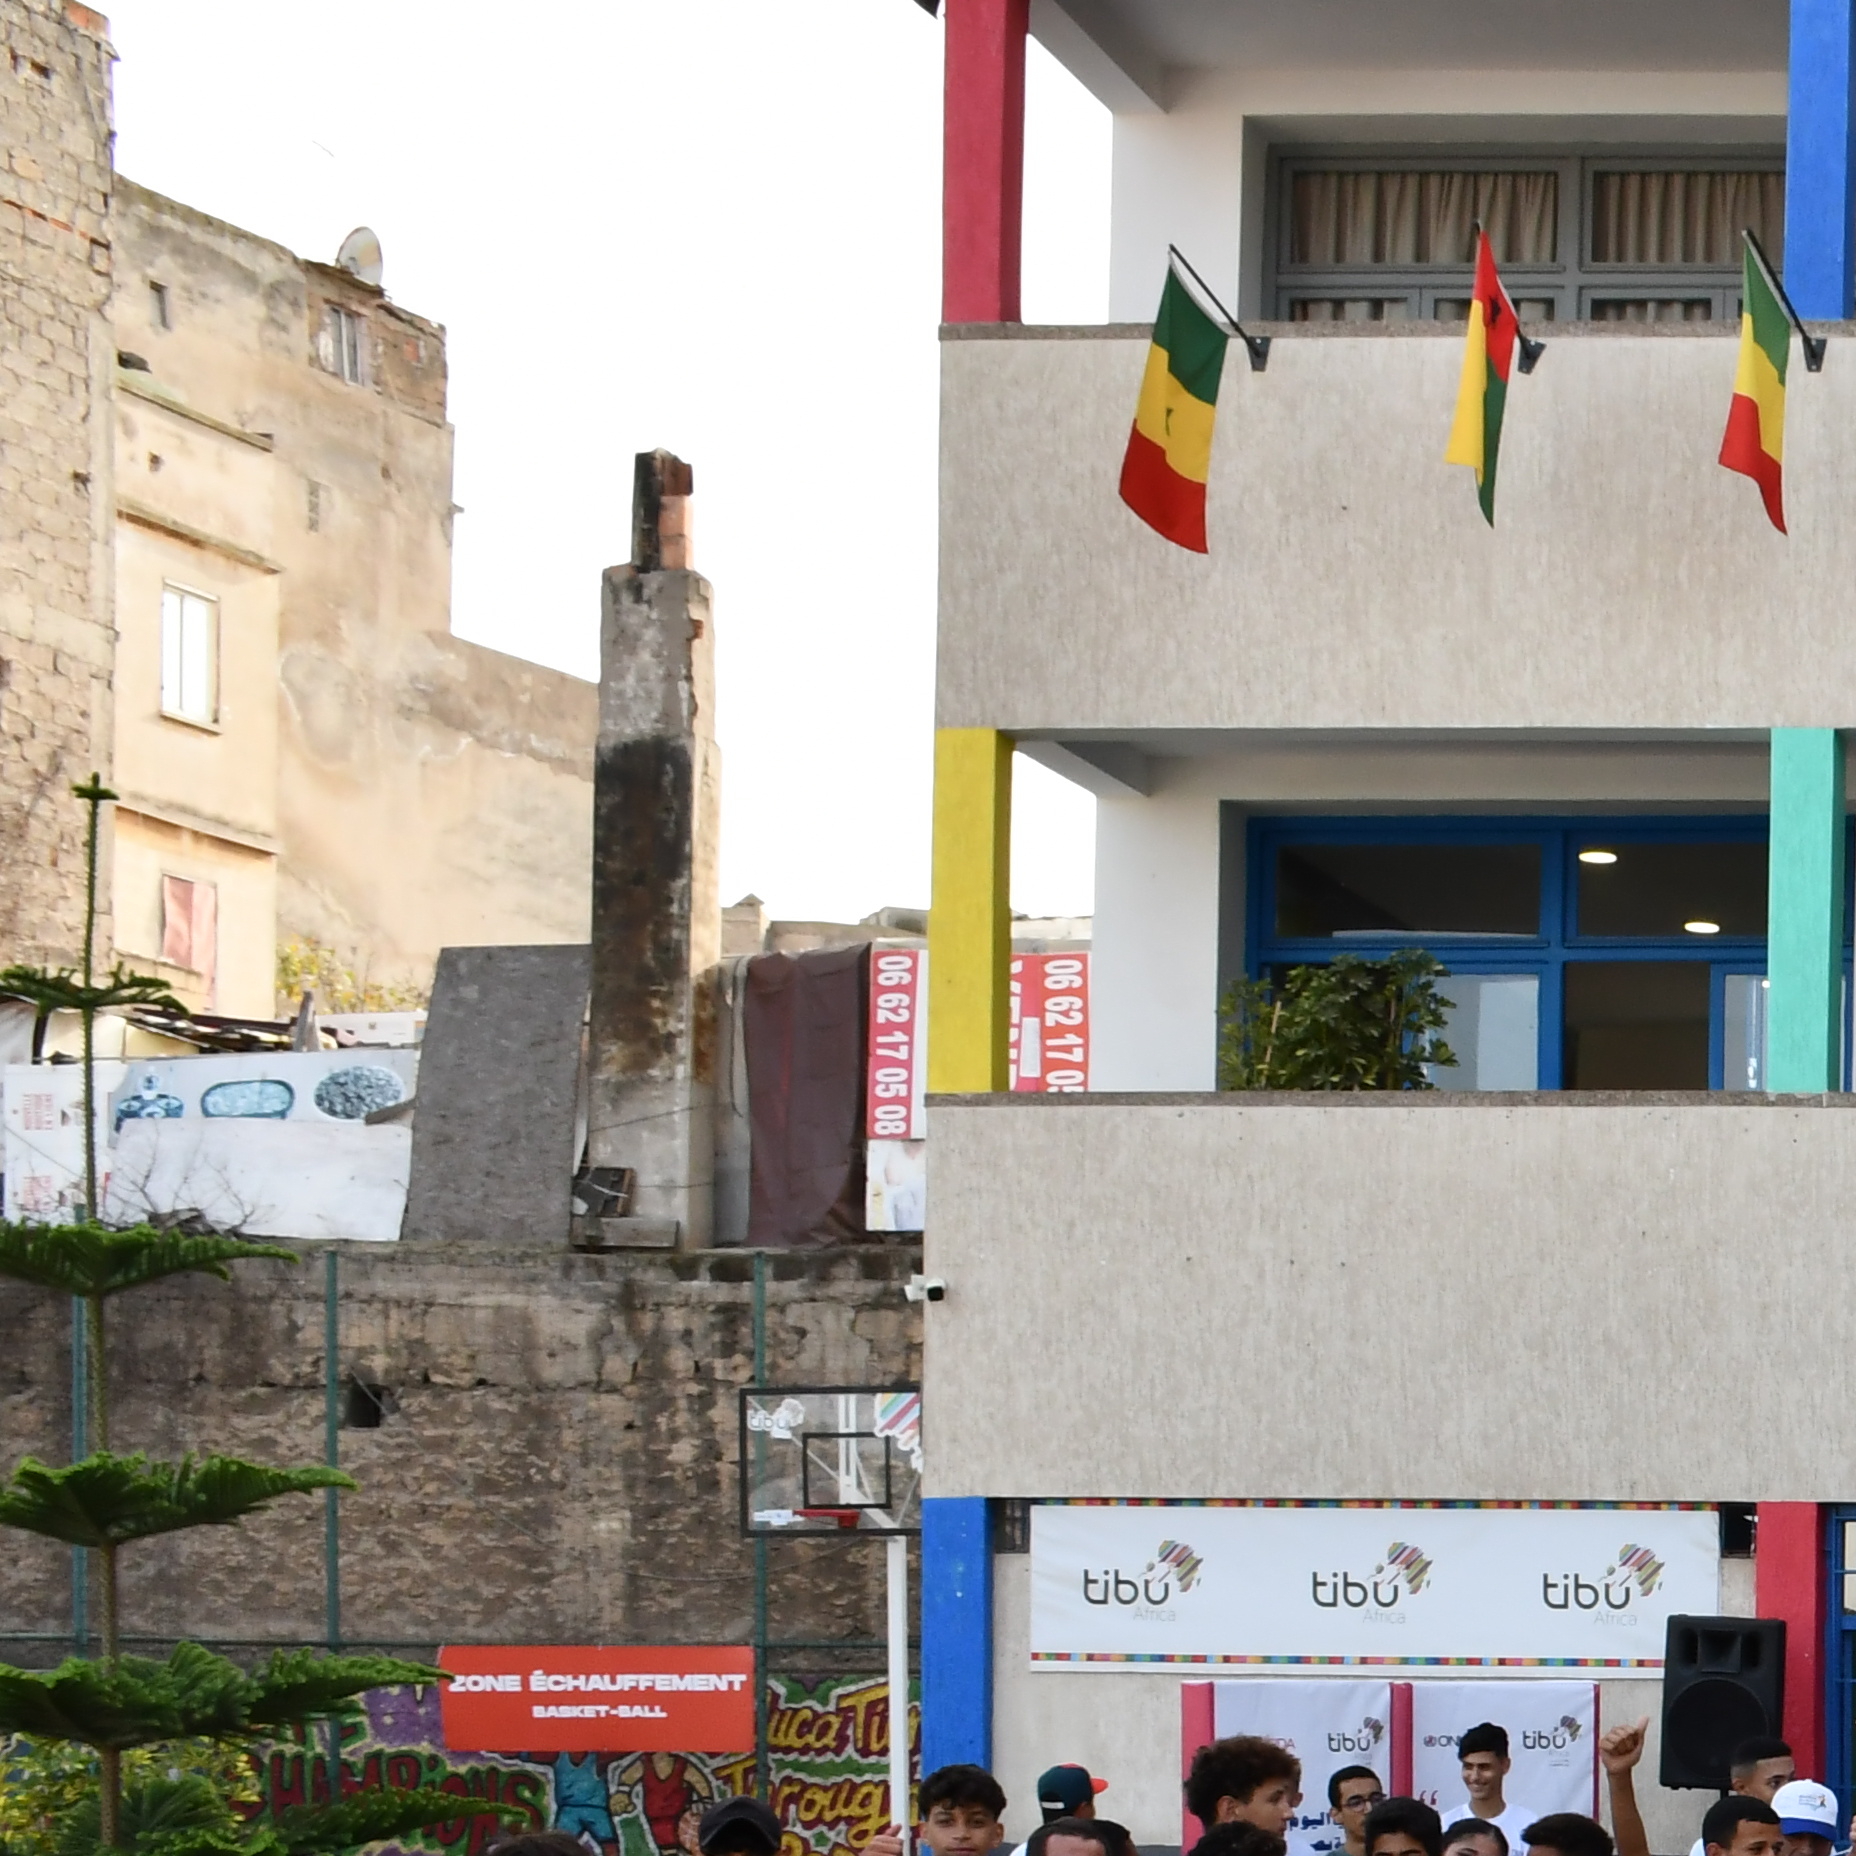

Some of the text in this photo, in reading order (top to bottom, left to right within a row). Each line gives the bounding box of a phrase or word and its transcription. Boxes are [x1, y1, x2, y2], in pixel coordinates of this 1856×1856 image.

[1044, 958, 1083, 990] 06
[1044, 995, 1084, 1027] 62
[874, 955, 912, 1135] 06 62 17 05 08
[1045, 1033, 1084, 1062] 17
[1083, 1568, 1169, 1605] tibu
[1312, 1571, 1398, 1607] tibu
[1543, 1573, 1630, 1609] tibu
[449, 1669, 748, 1692] ZONE ÉCHAUFFEMENT
[532, 1705, 668, 1718] BASKET-BALL
